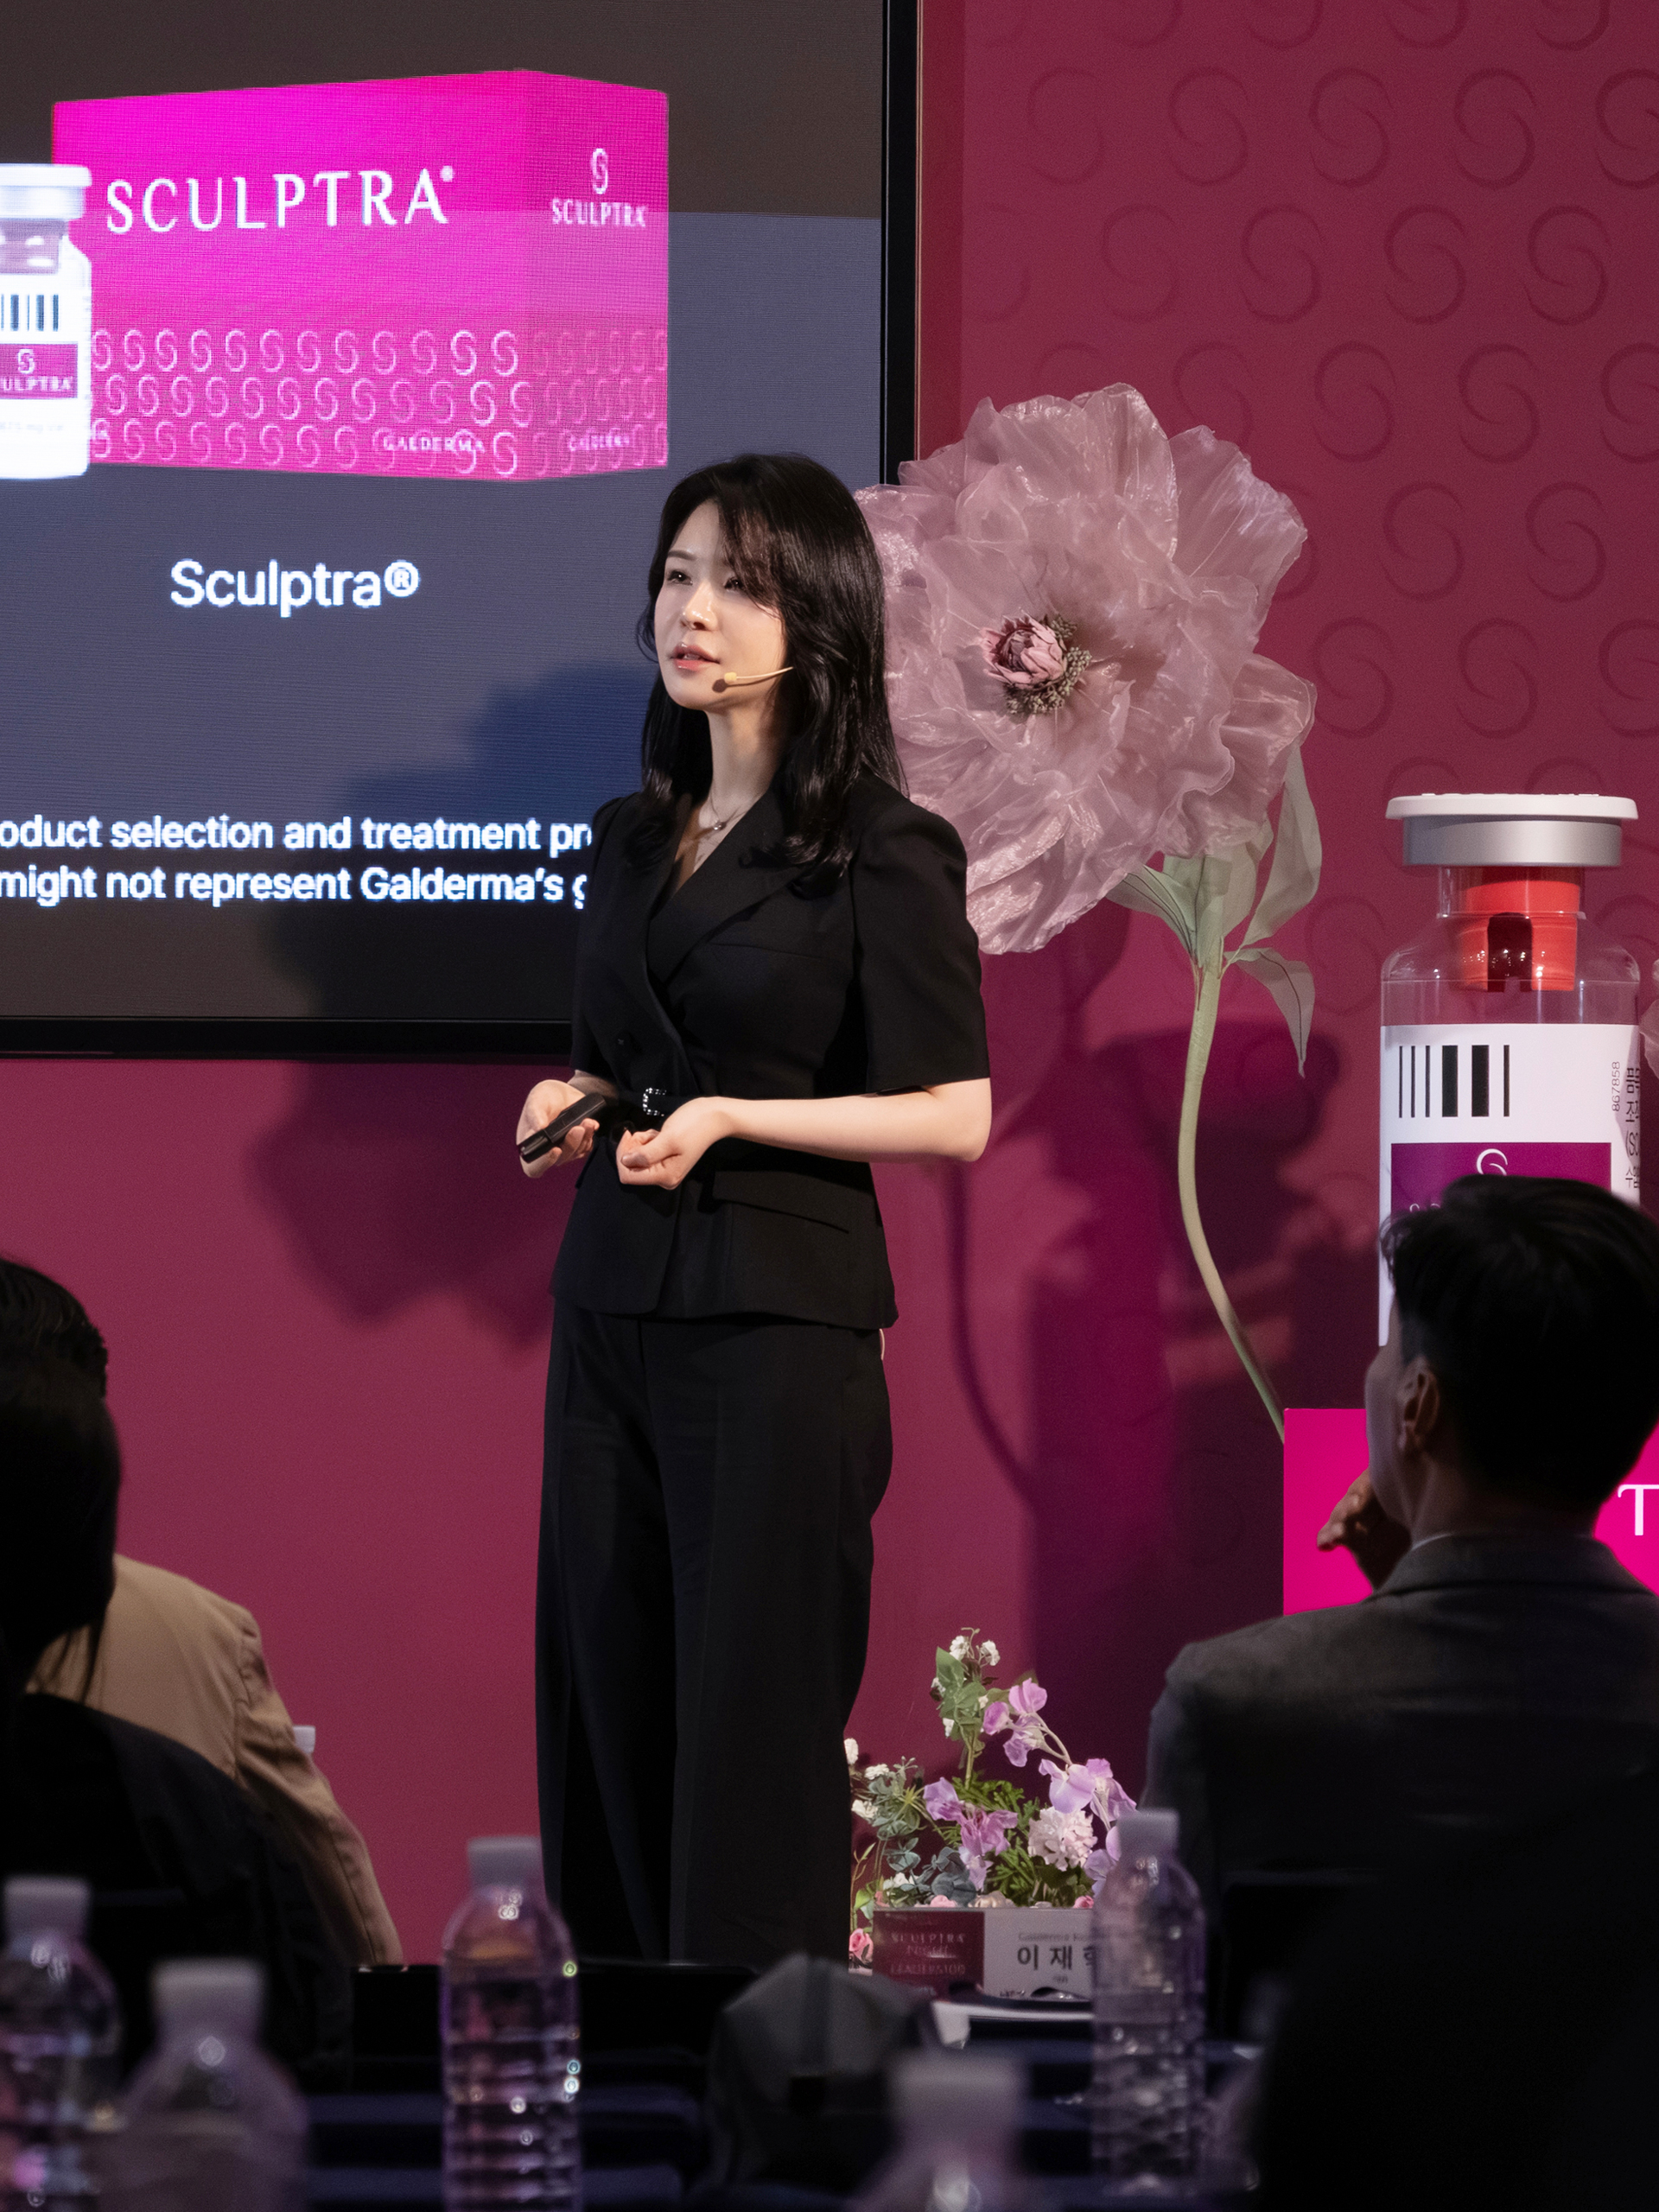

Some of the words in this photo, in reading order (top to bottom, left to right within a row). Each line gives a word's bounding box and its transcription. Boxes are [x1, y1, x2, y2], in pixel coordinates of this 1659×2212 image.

[0, 814, 103, 849] oduct
[110, 813, 273, 849] selection
[283, 816, 352, 850] and
[360, 817, 542, 850] treatment
[550, 823, 593, 859] pr
[0, 864, 98, 907] might
[105, 867, 167, 900] not
[175, 868, 352, 907] represent
[359, 867, 564, 901] Galderma's
